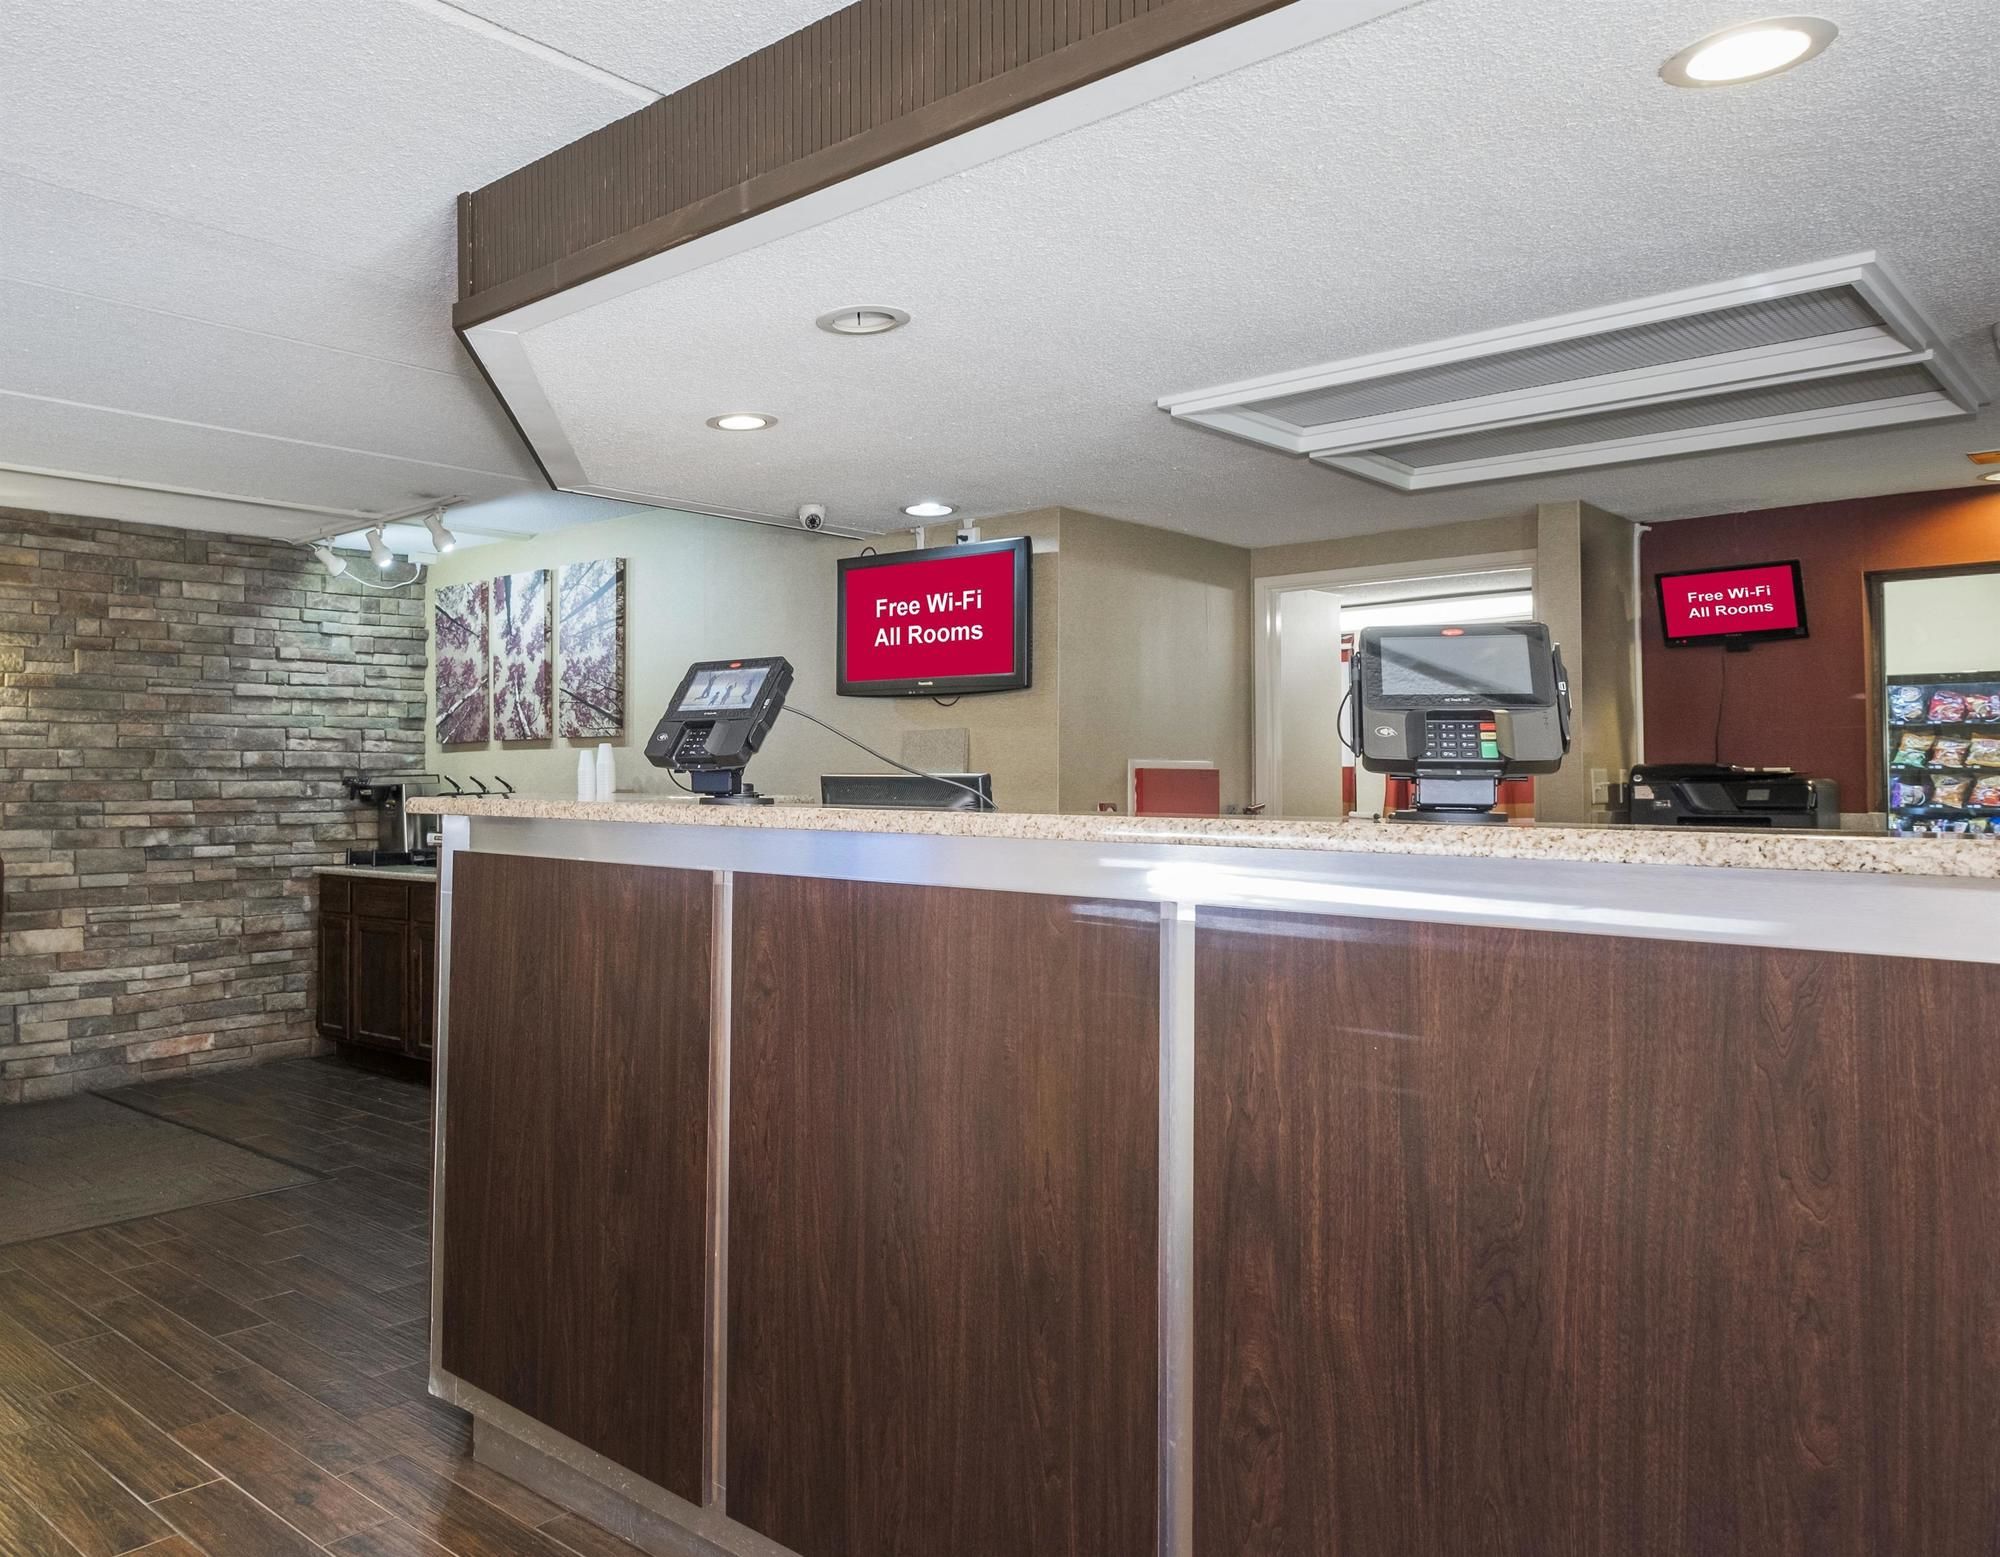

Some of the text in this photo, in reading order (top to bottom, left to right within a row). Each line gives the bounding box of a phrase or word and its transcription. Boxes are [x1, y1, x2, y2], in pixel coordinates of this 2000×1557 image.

[876, 589, 982, 618] Free Wi-Fi
[1687, 585, 1771, 603] Free Wi-Fi
[1688, 603, 1774, 619] All Rooms
[874, 624, 983, 647] All Rooms
